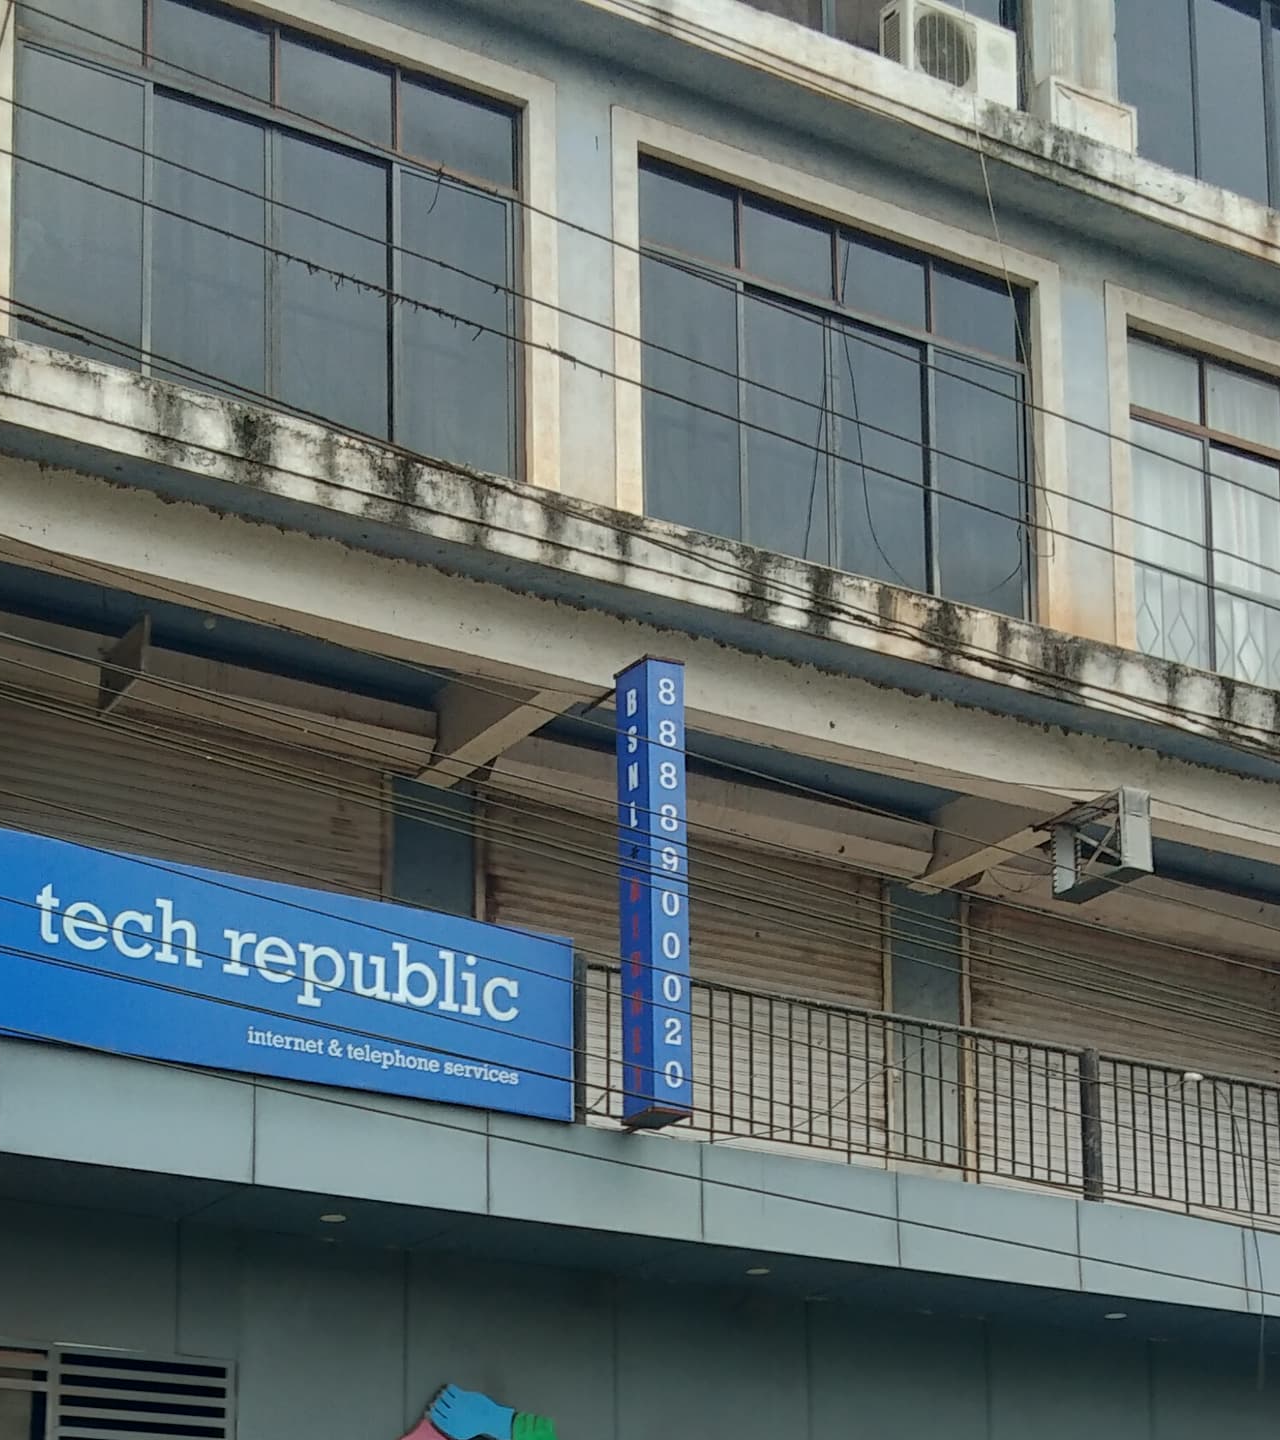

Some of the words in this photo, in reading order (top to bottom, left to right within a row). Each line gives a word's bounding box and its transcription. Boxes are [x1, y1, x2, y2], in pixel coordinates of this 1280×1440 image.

[36, 883, 203, 969] tech
[222, 927, 520, 1022] republic
[657, 677, 684, 1089] 8888900020
[247, 1025, 324, 1054] internet
[327, 1038, 344, 1058] &
[347, 1044, 440, 1073] telephone
[444, 1061, 520, 1086] services
